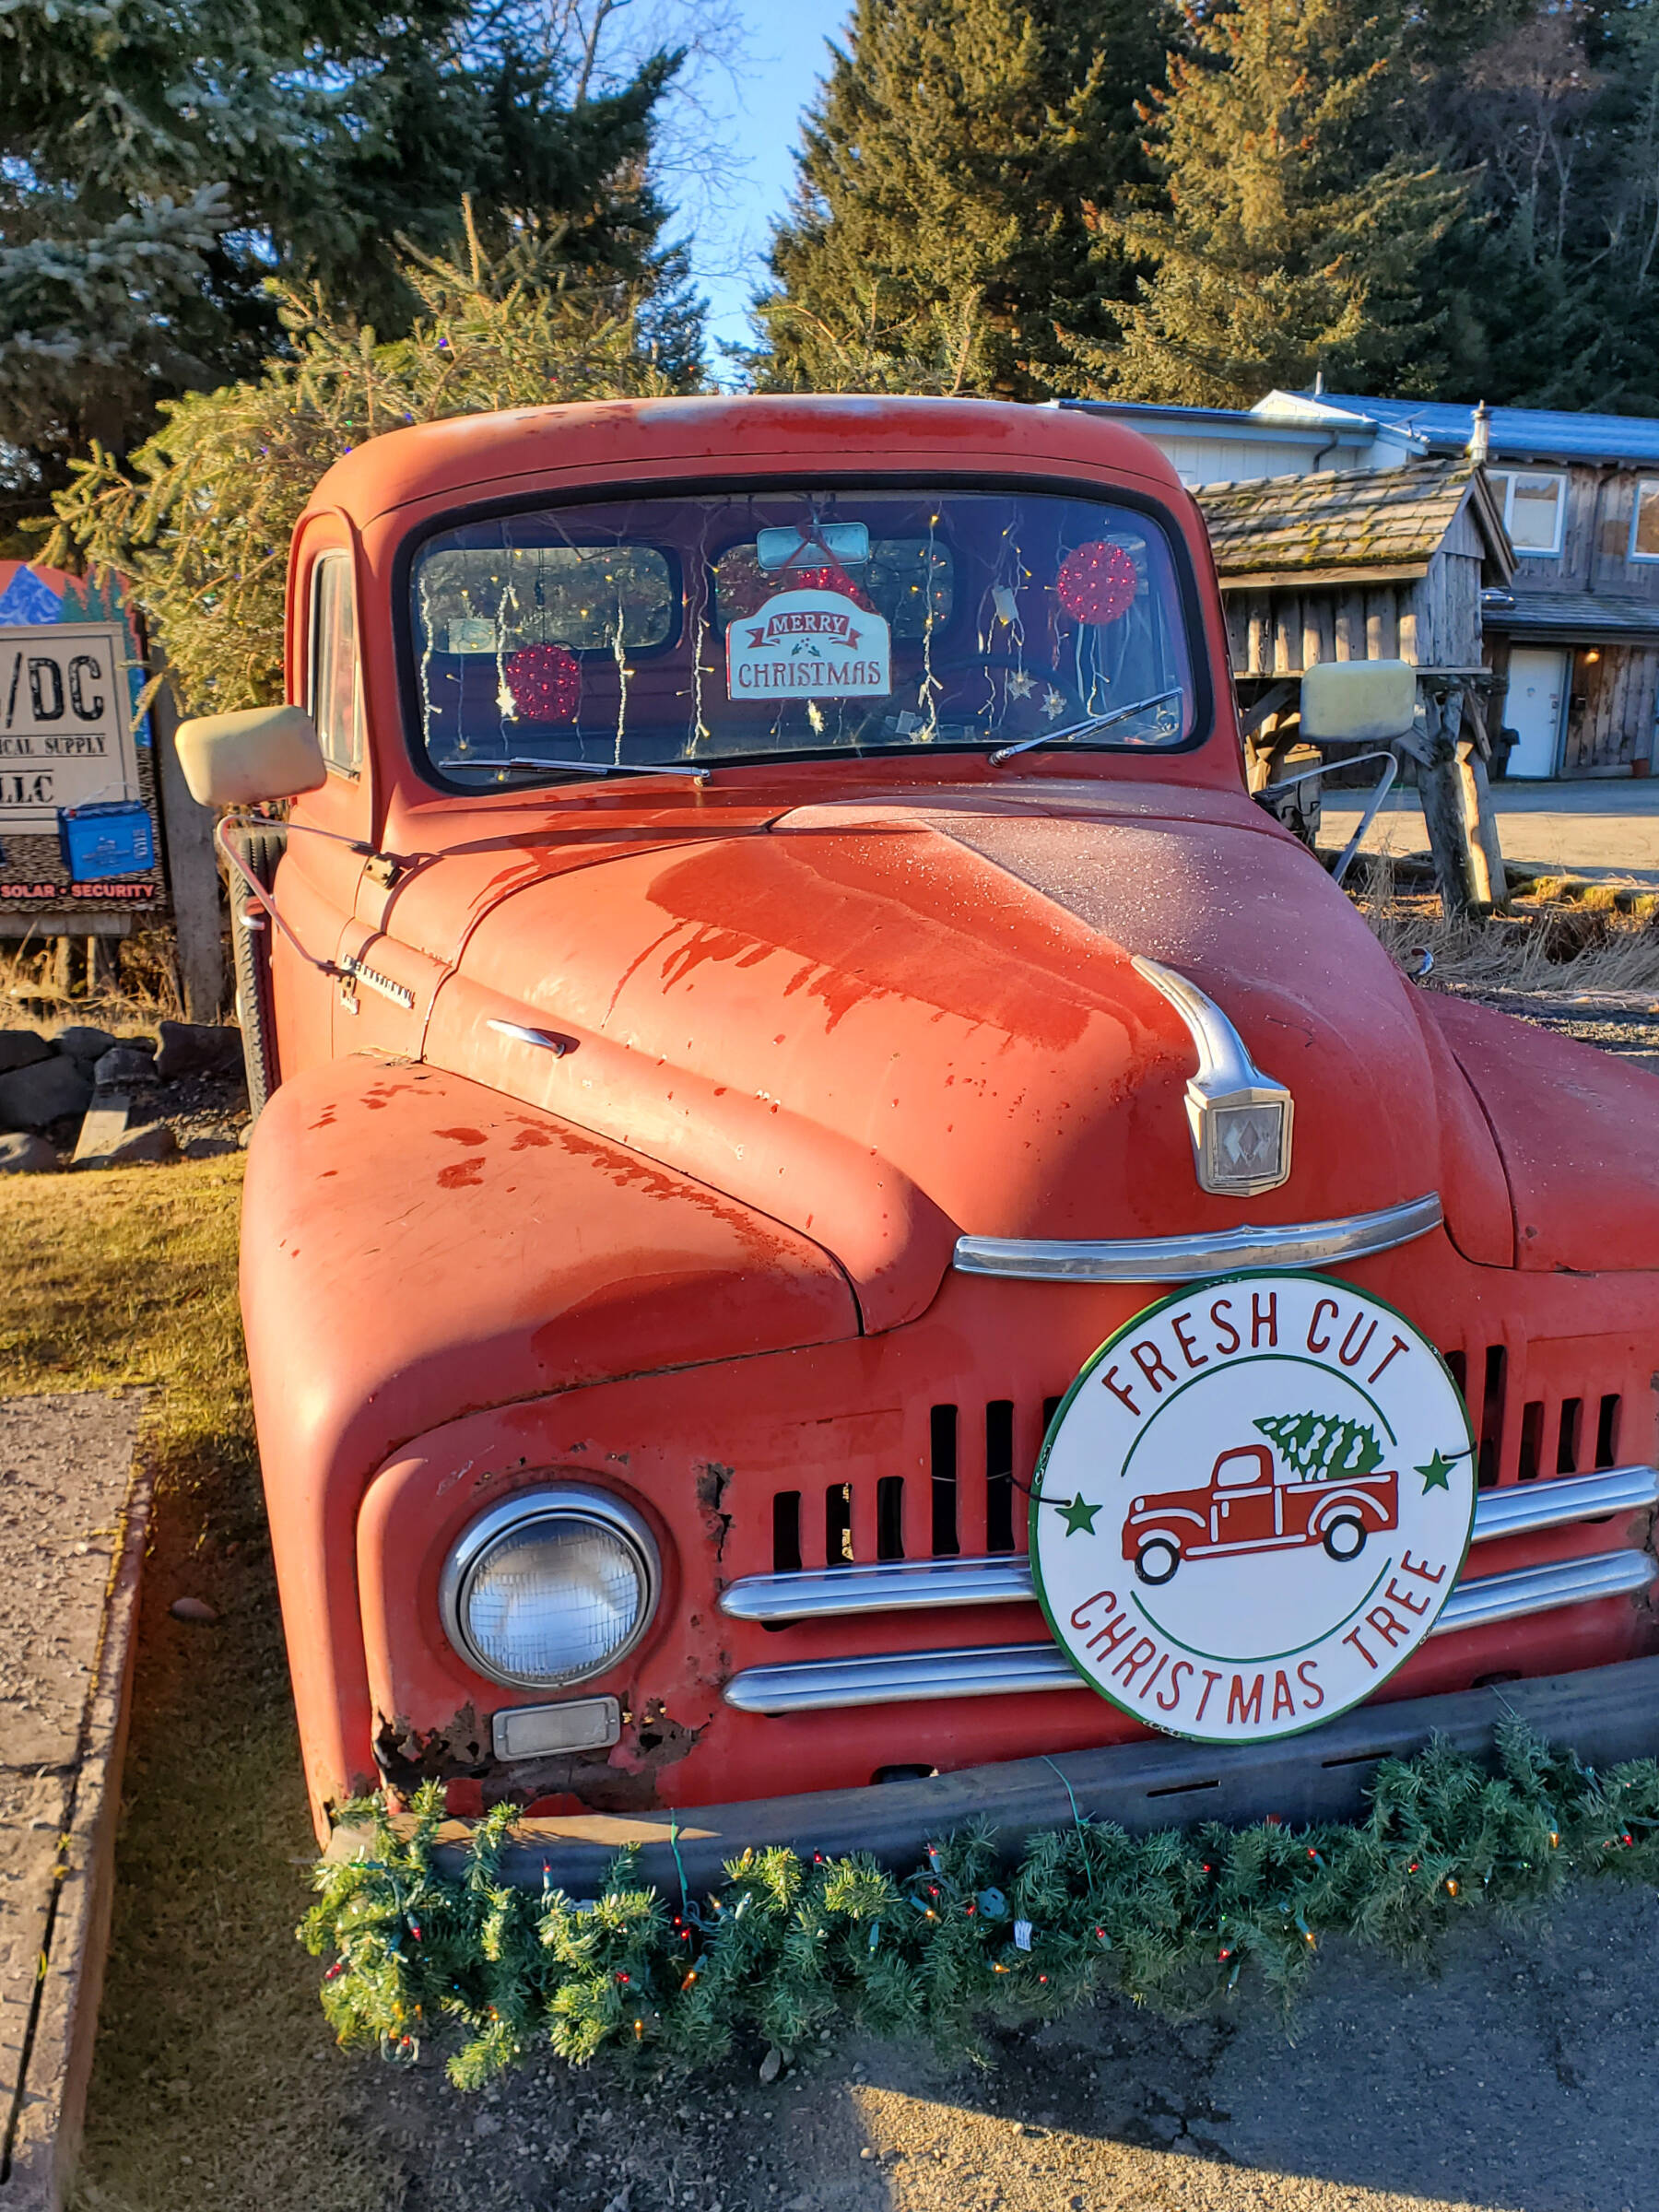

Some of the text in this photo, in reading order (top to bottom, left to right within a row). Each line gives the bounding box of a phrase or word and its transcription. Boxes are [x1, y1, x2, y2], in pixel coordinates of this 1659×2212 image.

[772, 614, 846, 634] MERRY
[738, 661, 881, 688] CHRISTMAS
[45, 737, 106, 754] SUPPLY
[0, 883, 155, 899] SOLAR SECURITY
[1100, 1291, 1410, 1416] FRESH CUT
[1070, 1549, 1447, 1724] CHRISTMAS TREE
